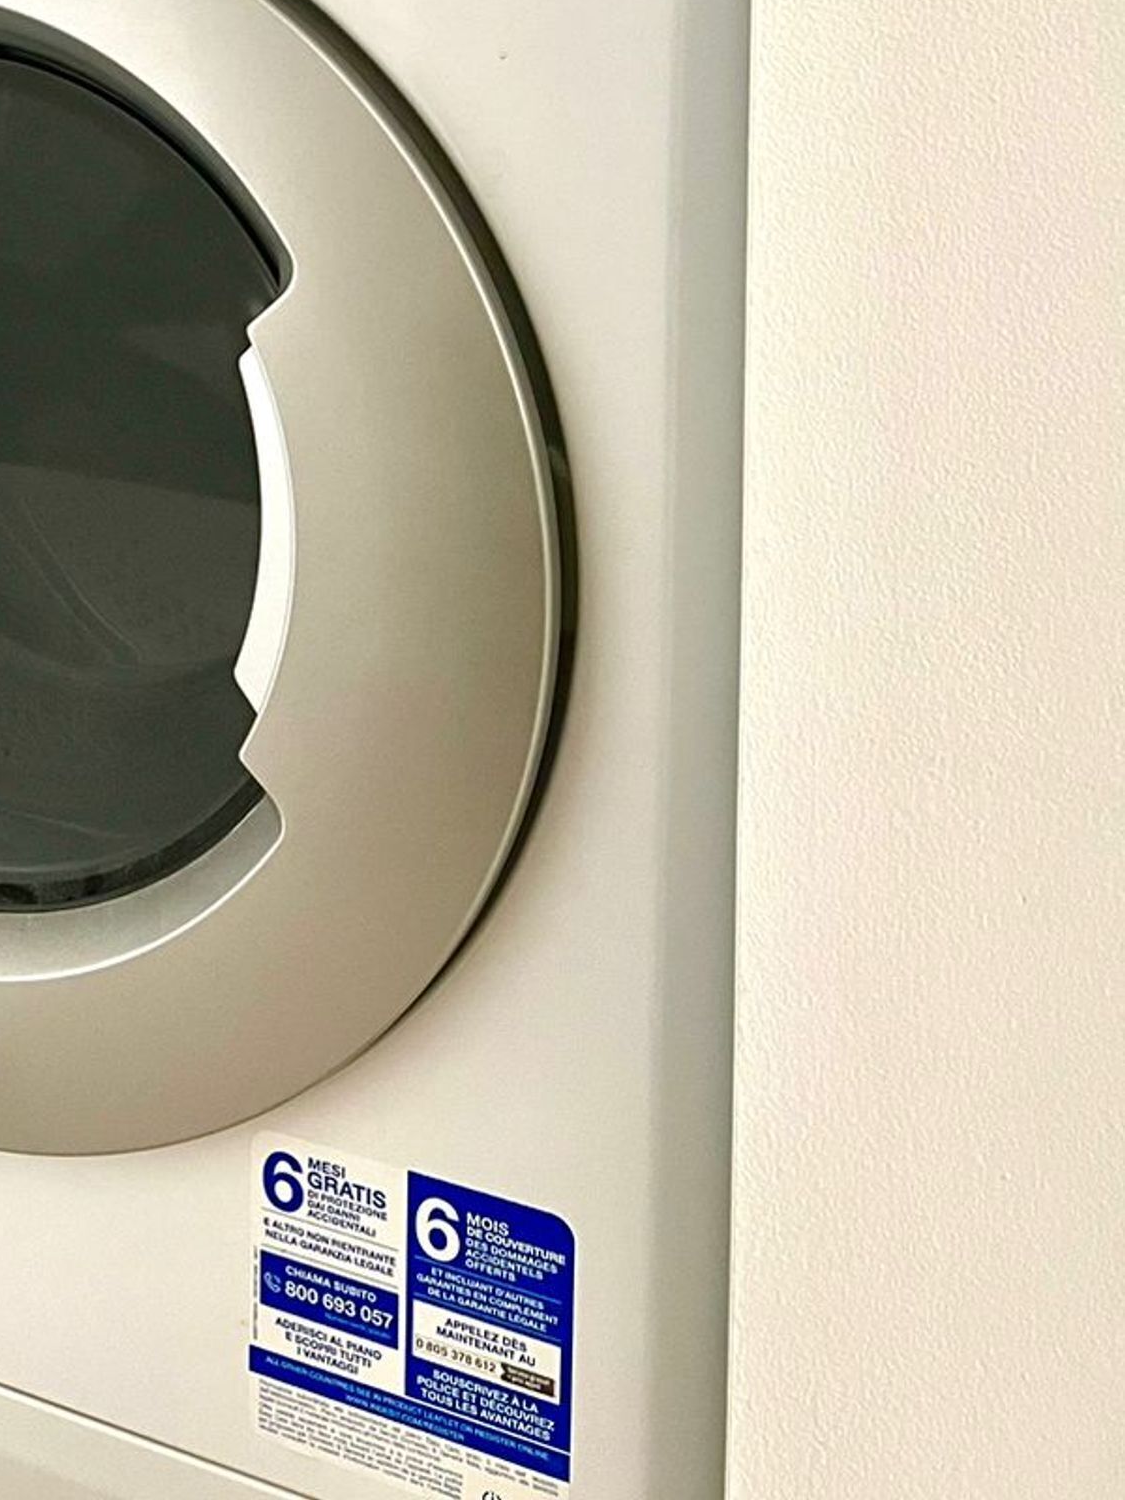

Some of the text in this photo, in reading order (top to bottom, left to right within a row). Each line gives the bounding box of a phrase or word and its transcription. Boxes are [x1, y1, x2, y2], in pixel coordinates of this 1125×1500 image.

[262, 1151, 346, 1213] 6 MESI
[307, 1172, 386, 1209] GRATIS
[307, 1209, 376, 1238] ACCIDENTALI
[321, 1191, 387, 1221] PROTEZIONE
[272, 1220, 305, 1236] ALTRO
[307, 1229, 329, 1245] NON
[415, 1197, 509, 1262] 6 MOIS
[466, 1226, 566, 1266] DE COUVERTURE
[265, 1229, 395, 1277] NELLA GARANZIA LEGALE
[465, 1238, 558, 1274] DES DOMMAGES
[465, 1249, 543, 1280] ACCIDENTELS
[465, 1258, 517, 1282] OFFERTS
[285, 1265, 377, 1303] CHIAMA SUBITO
[442, 1290, 455, 1302] LA
[444, 1270, 493, 1294] INCLUANT
[285, 1280, 318, 1305] 800
[322, 1293, 356, 1317] 693
[360, 1305, 393, 1329] 057
[275, 1317, 328, 1342] ADERISCI
[330, 1336, 344, 1347] AL
[346, 1341, 382, 1361] PIANO
[285, 1331, 372, 1368] E SCOPRI TUTTI
[436, 1326, 536, 1367] MAINTENANT AU
[444, 1318, 500, 1344] APPELEZ
[303, 1348, 359, 1374] VANTAGGI
[416, 1375, 461, 1398] POLICE
[462, 1391, 477, 1404] ET
[433, 1369, 509, 1404] SOUSCRIVEZ
[522, 1399, 539, 1413] LA
[421, 1387, 551, 1441] TOUS LES AVANTAGES
